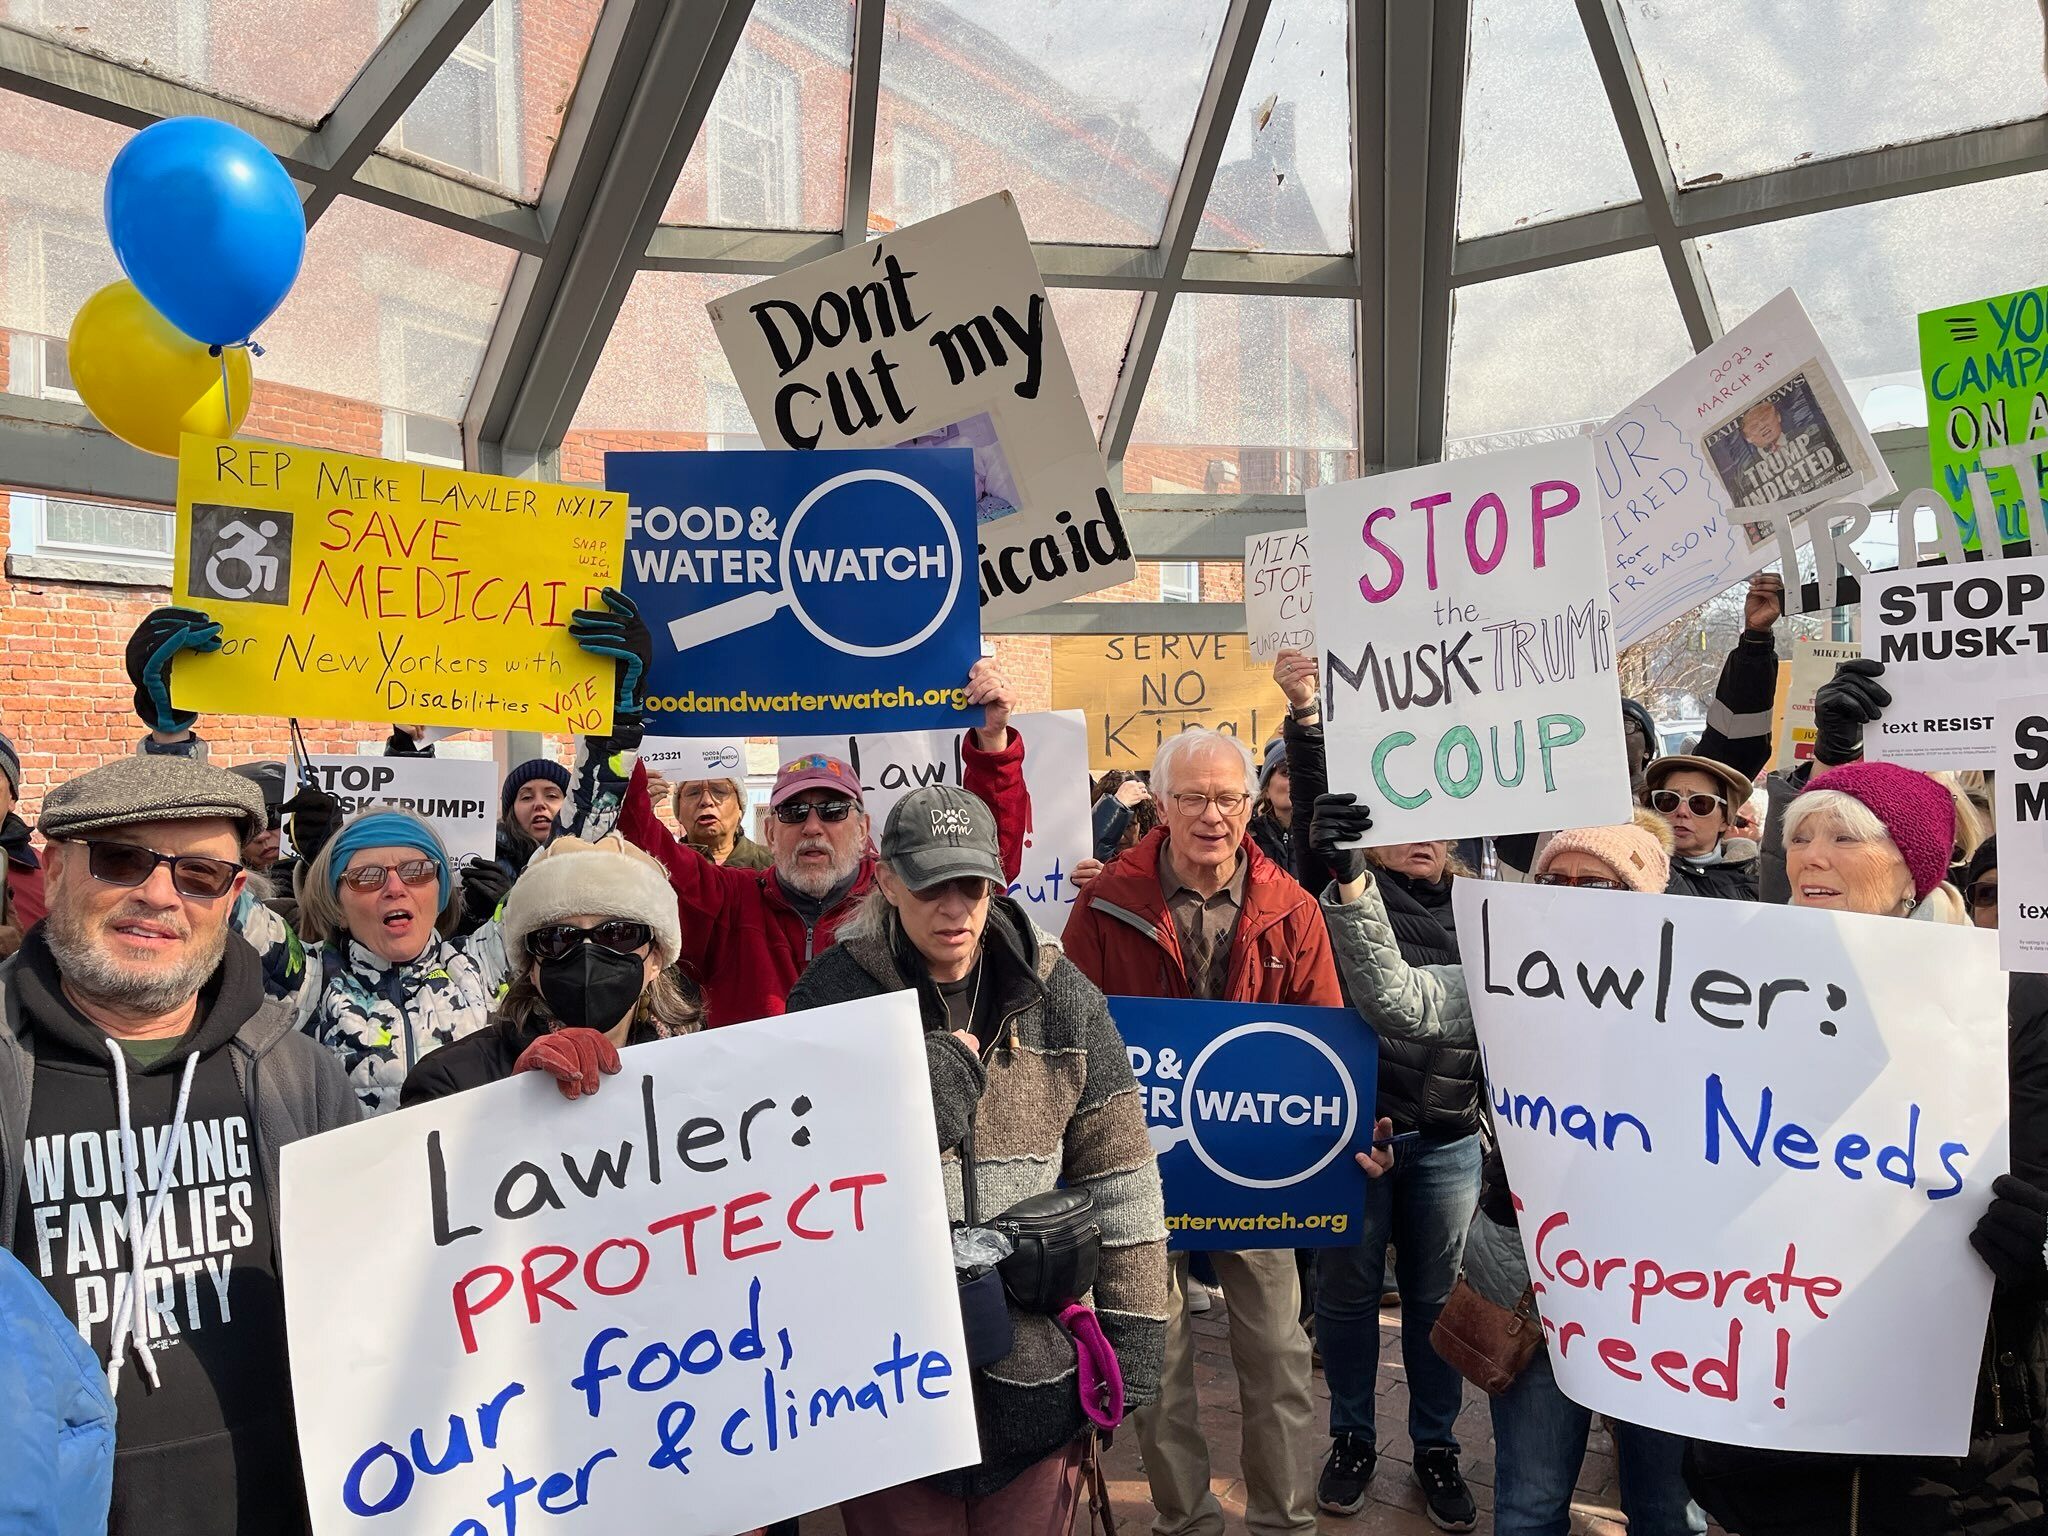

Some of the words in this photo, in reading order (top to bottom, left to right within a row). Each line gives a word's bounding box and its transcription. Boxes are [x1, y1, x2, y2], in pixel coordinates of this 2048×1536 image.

[749, 243, 932, 378] Don't
[1987, 290, 2048, 350] YO
[930, 294, 1044, 399] my
[1710, 346, 1752, 382] 2023
[1697, 373, 1751, 418] MARCH
[1762, 376, 1805, 404] EWS
[1946, 399, 2010, 453] ON
[216, 445, 291, 490] REP
[316, 461, 401, 502] MIKE
[420, 469, 538, 517] LAWLER
[1743, 446, 1834, 507] INDICTED
[1744, 433, 1810, 489] TRUMP
[1601, 467, 1688, 546] IRED
[320, 509, 462, 562] SAVE
[978, 487, 1131, 607] icaid
[1358, 480, 1581, 603] STOP
[1608, 517, 1718, 603] TREASON
[1616, 545, 1650, 569] for
[631, 549, 775, 583] WATER
[794, 545, 946, 582] WATCH
[1434, 597, 1484, 627] the
[1879, 574, 2045, 626] STOP
[219, 637, 257, 656] or
[273, 633, 369, 681] New
[376, 631, 488, 694] Yorkers
[505, 651, 562, 675] with
[1105, 634, 1227, 660] SERVE
[1326, 599, 1611, 722] MUSK-TRUMP
[1812, 648, 1840, 658] MIKE
[387, 681, 530, 713] Disabilities
[539, 675, 597, 715] VOTE
[1142, 670, 1206, 706] NO
[567, 707, 602, 735] NO
[1881, 721, 1918, 734] text
[1923, 716, 1995, 733] RESIST
[298, 765, 395, 791] STOP
[652, 751, 681, 761] 23321
[1371, 713, 1586, 810] COUP
[931, 824, 973, 837] mom
[1007, 856, 1077, 903] ut
[1481, 898, 1849, 1037] Lawler:
[1196, 1089, 1341, 1126] WATCH
[24, 1116, 251, 1204] WORKING
[427, 1075, 812, 1247] Lawler:
[1705, 1073, 1971, 1200] Needs
[1164, 1212, 1348, 1233] aterwatch.org
[452, 1173, 888, 1355] PROTECT
[1535, 1211, 1843, 1325] Corporate
[343, 1381, 525, 1518] our
[570, 1276, 793, 1418] food,
[648, 1401, 697, 1475] &
[720, 1333, 954, 1456] climate
